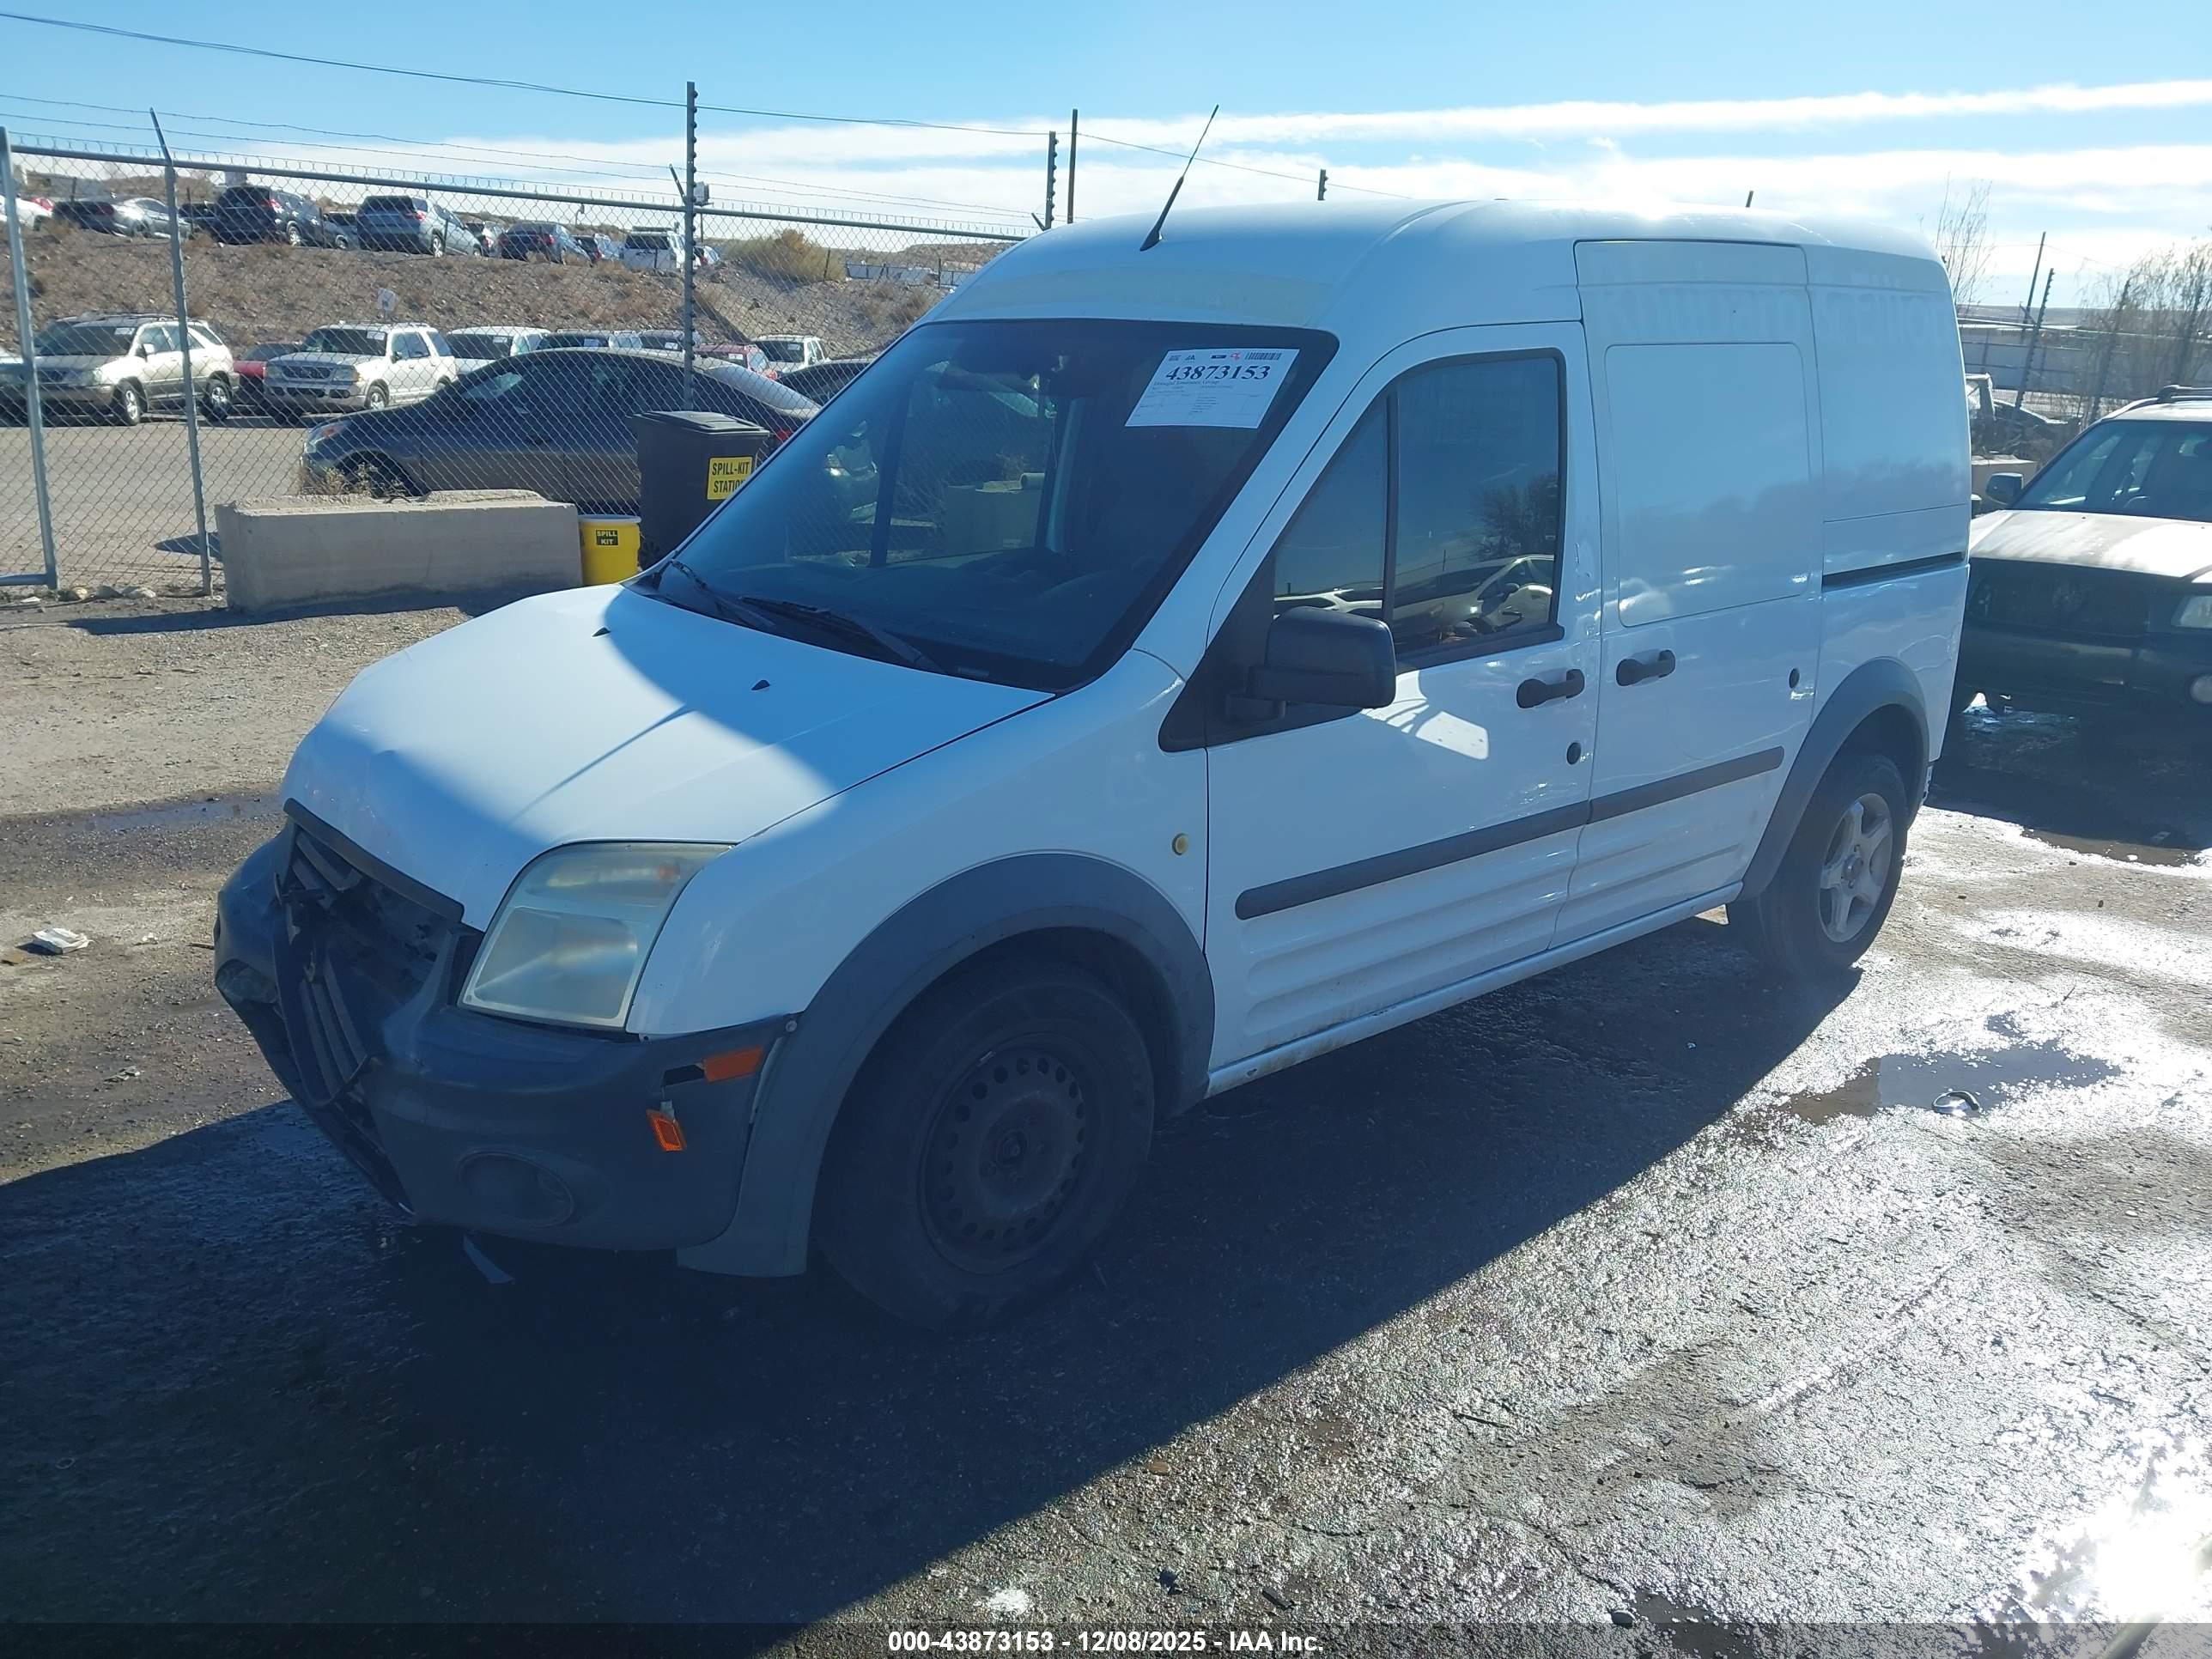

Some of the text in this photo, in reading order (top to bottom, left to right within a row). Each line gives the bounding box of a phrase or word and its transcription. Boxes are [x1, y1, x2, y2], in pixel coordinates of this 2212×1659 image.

[1165, 365, 1271, 380] 43873153
[712, 461, 750, 476] SPILL-KIT
[714, 478, 745, 493] STATIO
